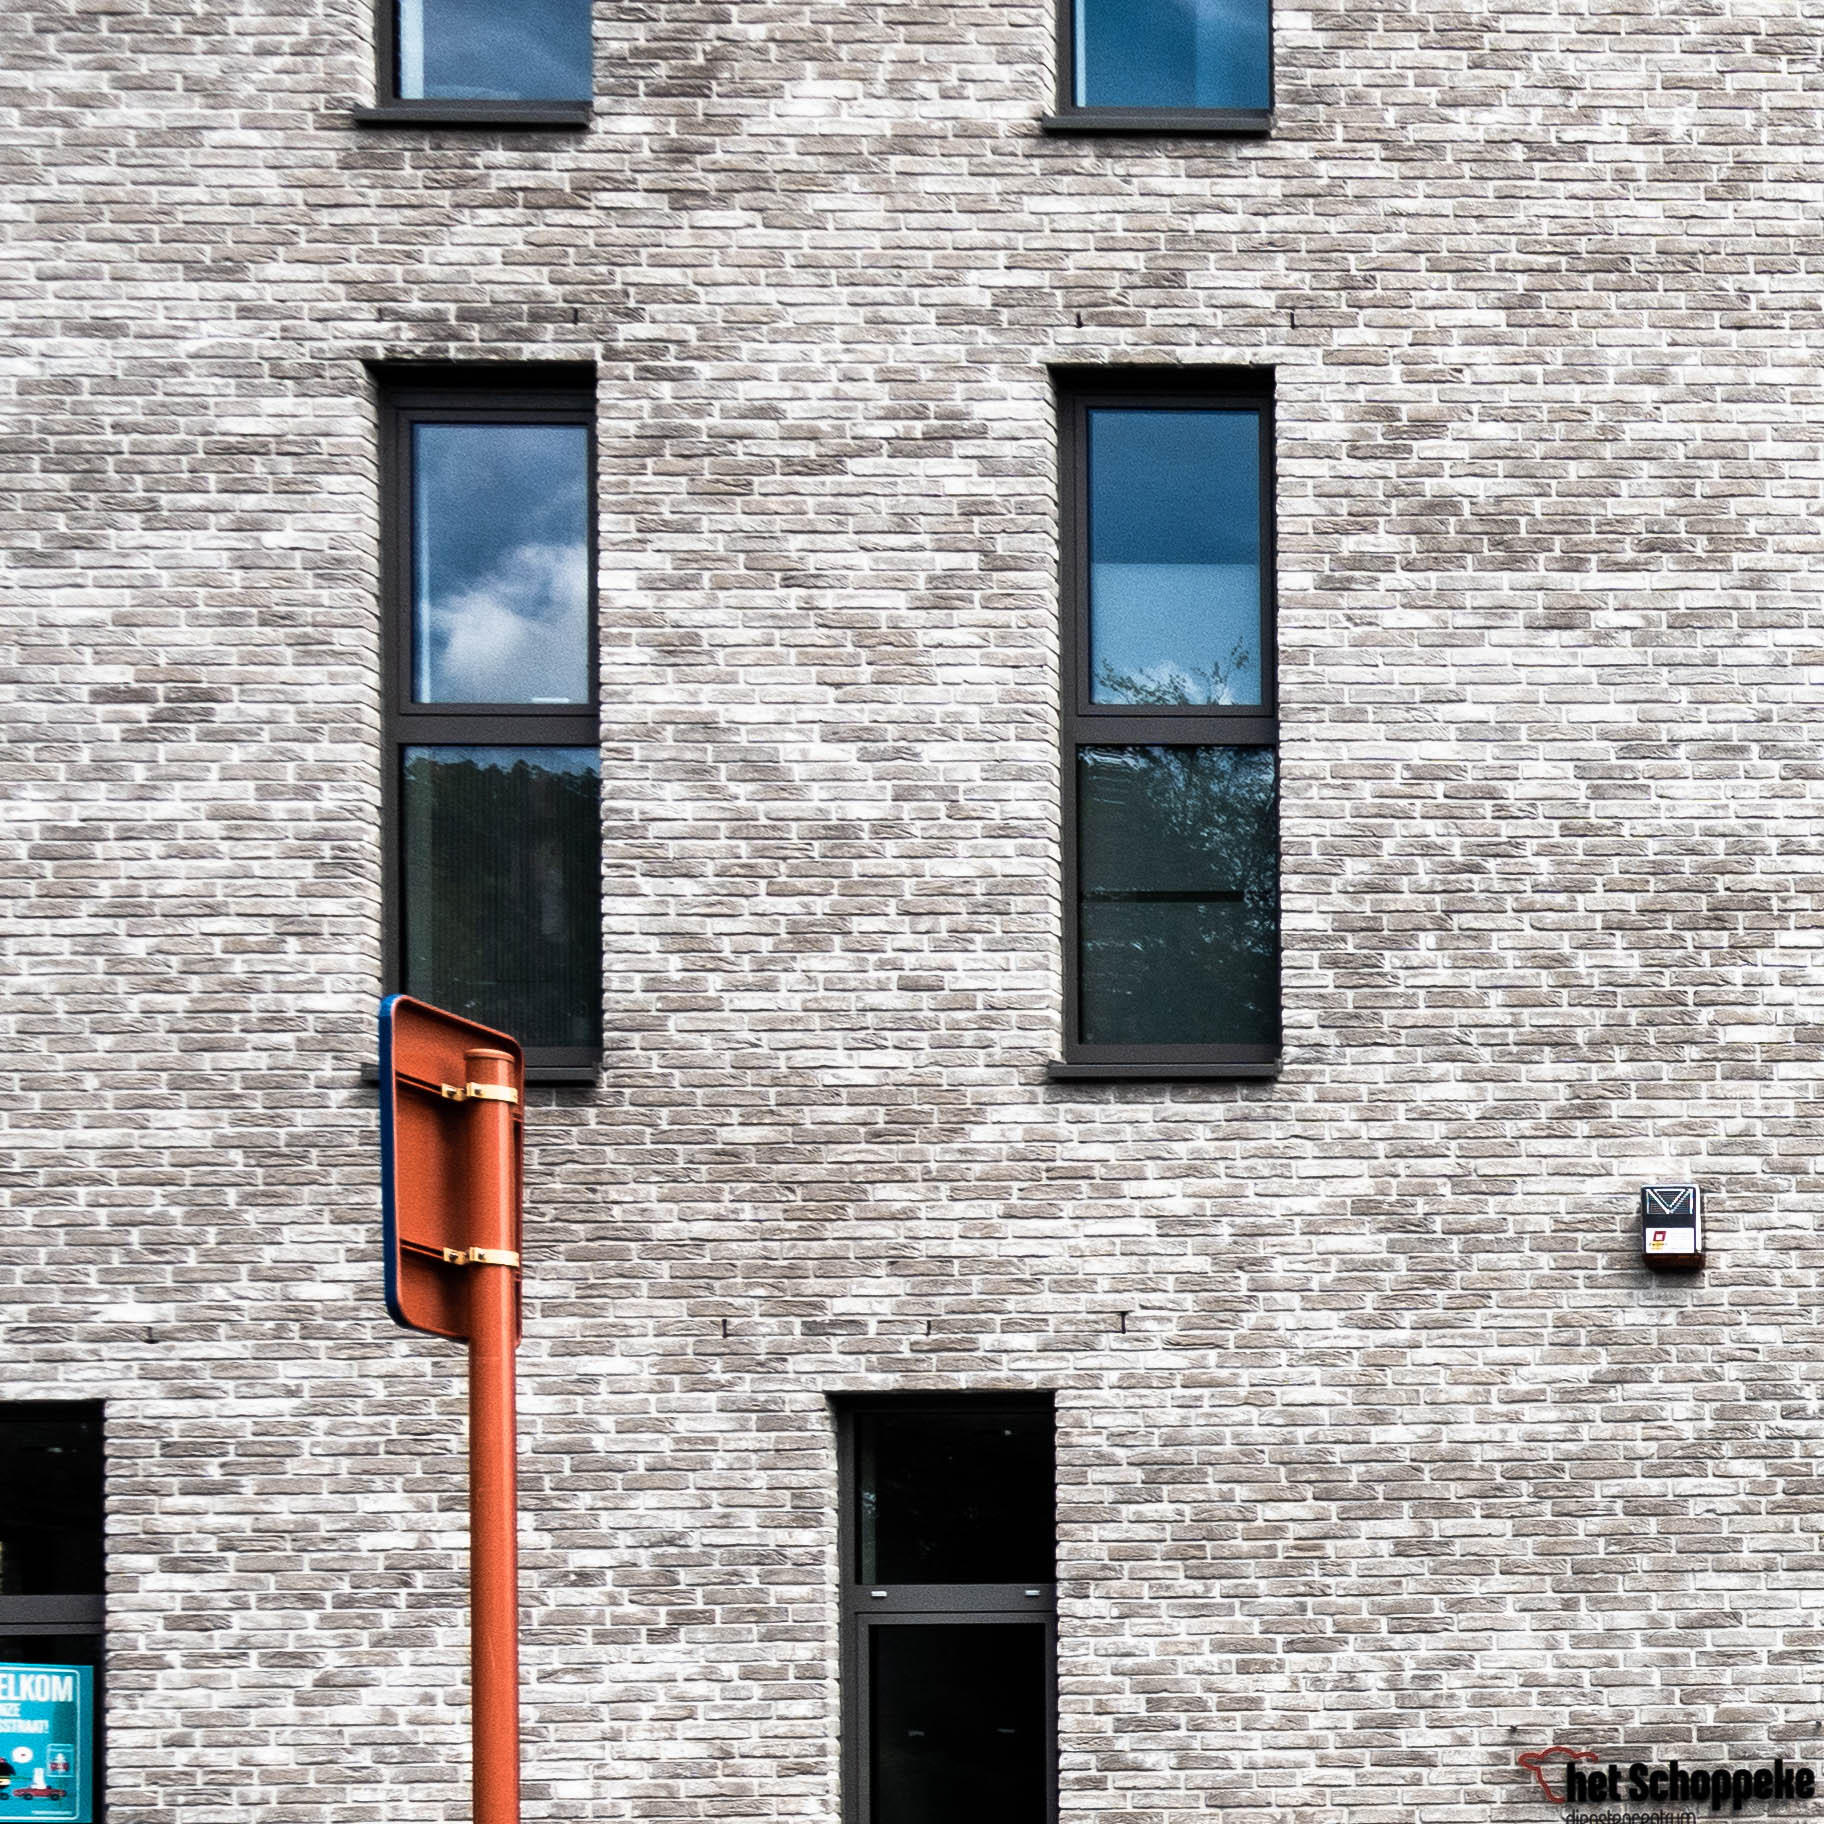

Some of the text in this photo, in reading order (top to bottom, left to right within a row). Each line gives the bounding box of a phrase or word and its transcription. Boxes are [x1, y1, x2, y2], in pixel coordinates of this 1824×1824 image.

[0, 1673, 73, 1702] ELKOM
[1565, 1758, 1816, 1811] het Schoppeke
